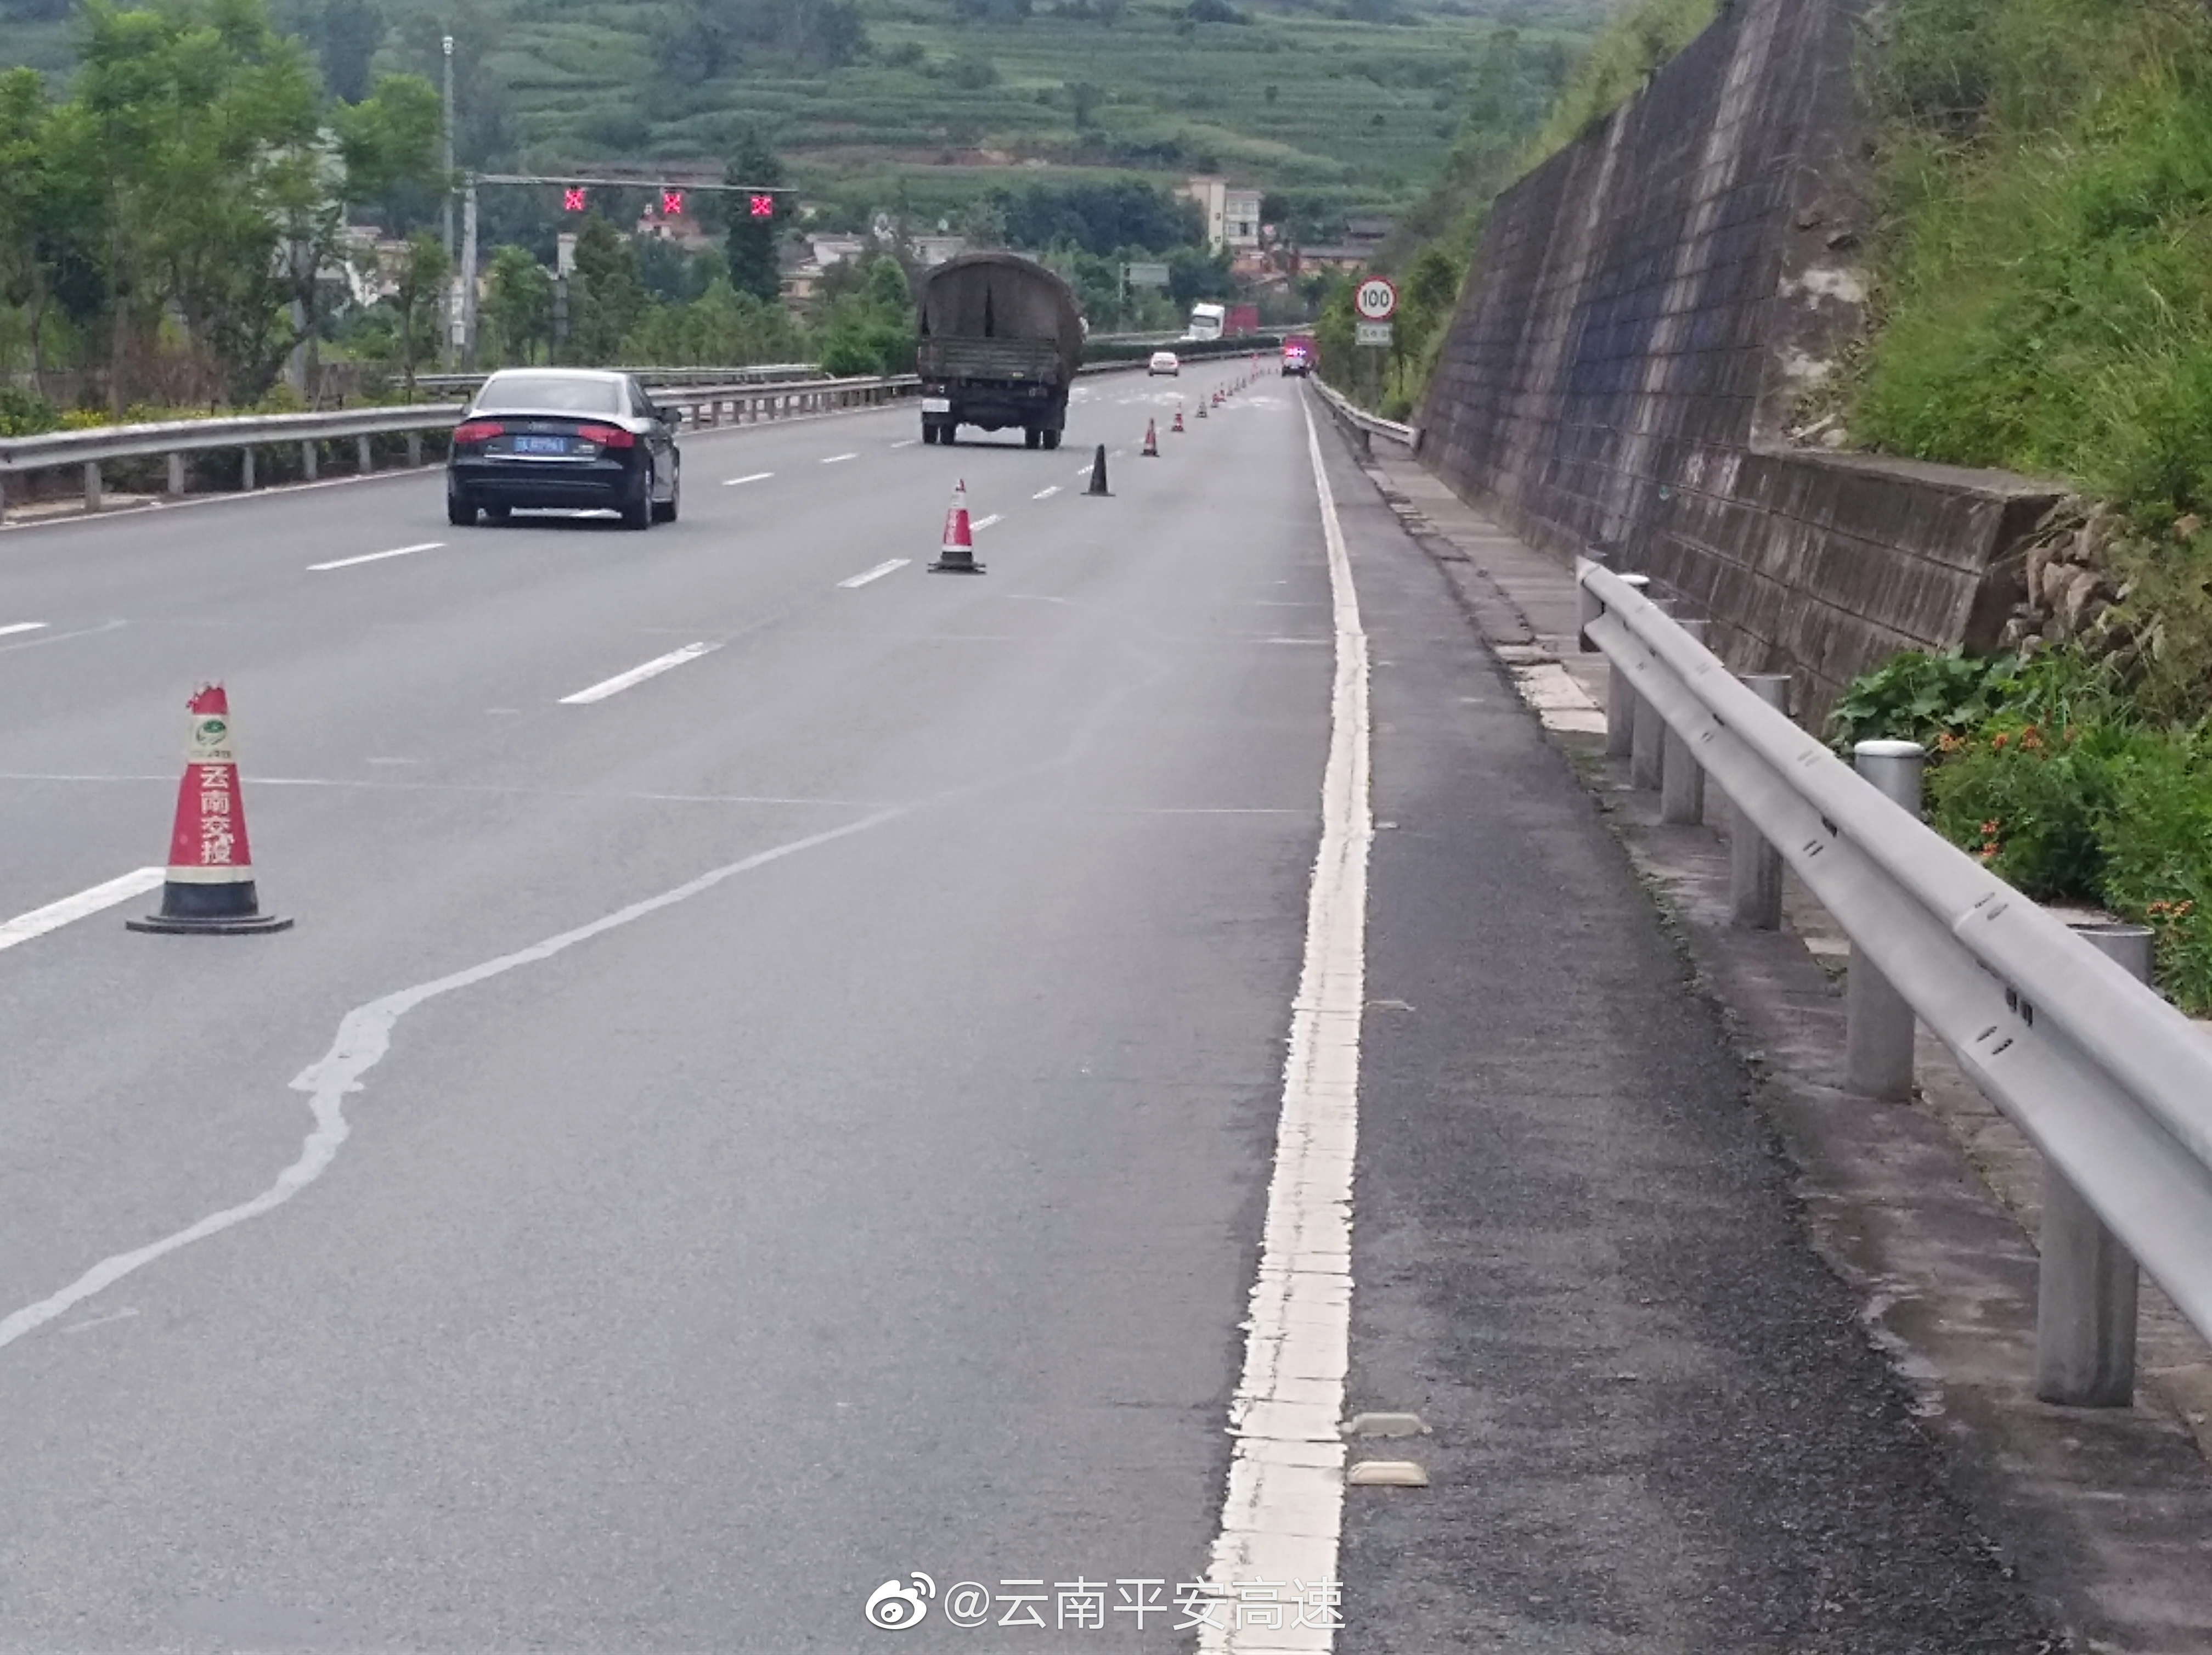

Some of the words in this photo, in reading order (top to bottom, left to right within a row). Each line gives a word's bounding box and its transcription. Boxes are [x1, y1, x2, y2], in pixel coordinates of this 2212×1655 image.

[1363, 290, 1389, 307] 100
[200, 766, 233, 864] 云南交投
